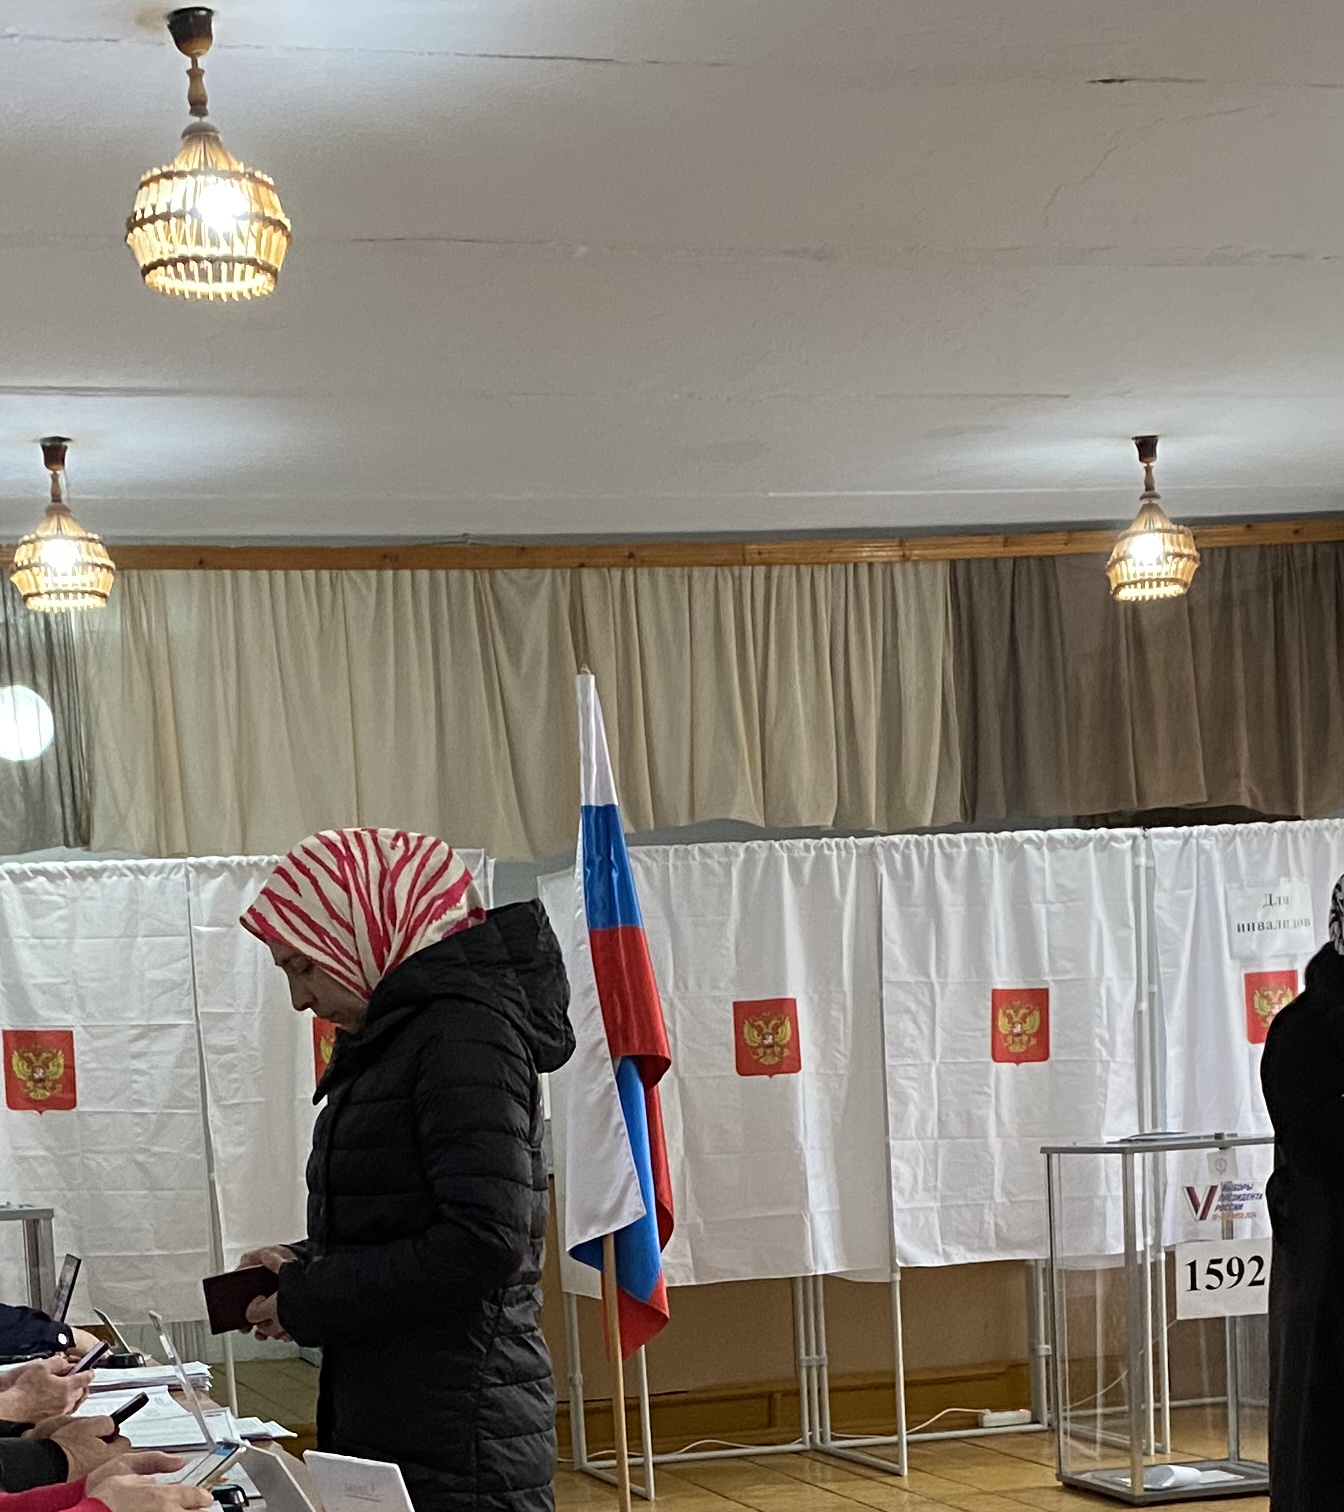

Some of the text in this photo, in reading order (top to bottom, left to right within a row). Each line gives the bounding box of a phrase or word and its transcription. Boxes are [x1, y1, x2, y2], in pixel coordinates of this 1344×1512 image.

[1262, 893, 1290, 909] Для
[1214, 1203, 1244, 1212] РОССИИ
[1185, 1255, 1266, 1292] 1592
